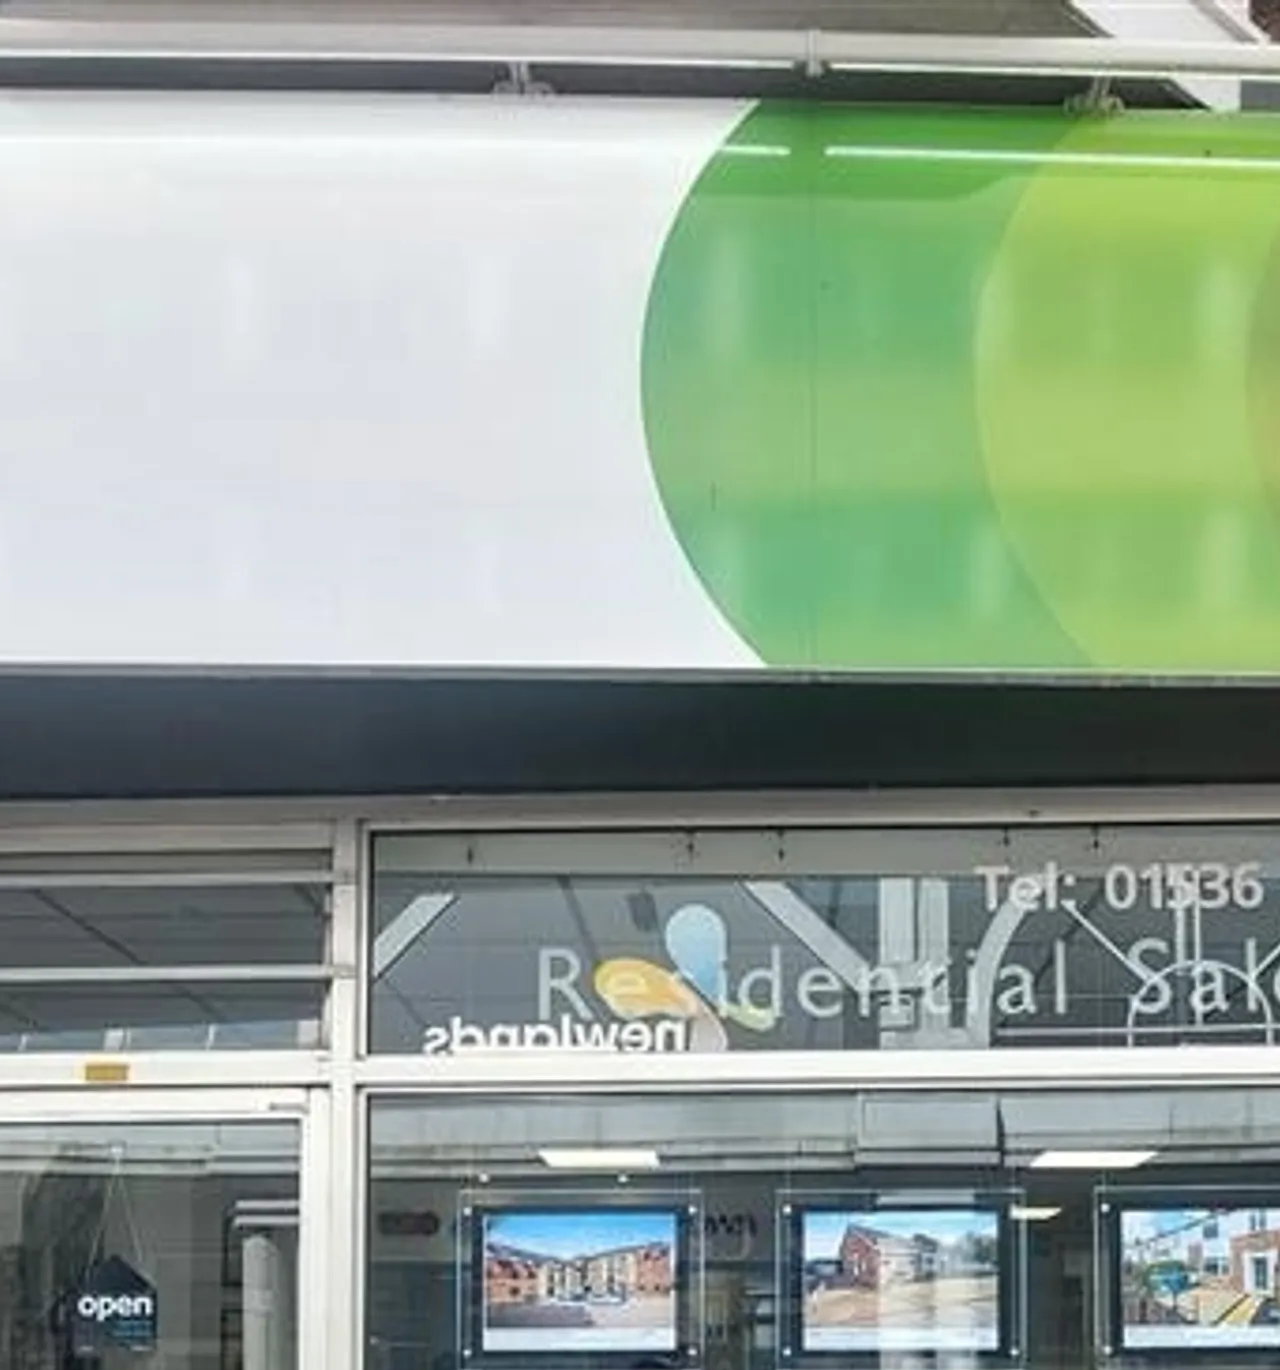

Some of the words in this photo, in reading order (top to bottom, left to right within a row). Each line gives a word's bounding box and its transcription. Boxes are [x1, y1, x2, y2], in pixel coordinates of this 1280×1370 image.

[975, 861, 1077, 911] Tel:
[1104, 864, 1264, 910] 01536
[537, 938, 1067, 1021] Reidential
[77, 1294, 153, 1322] open
